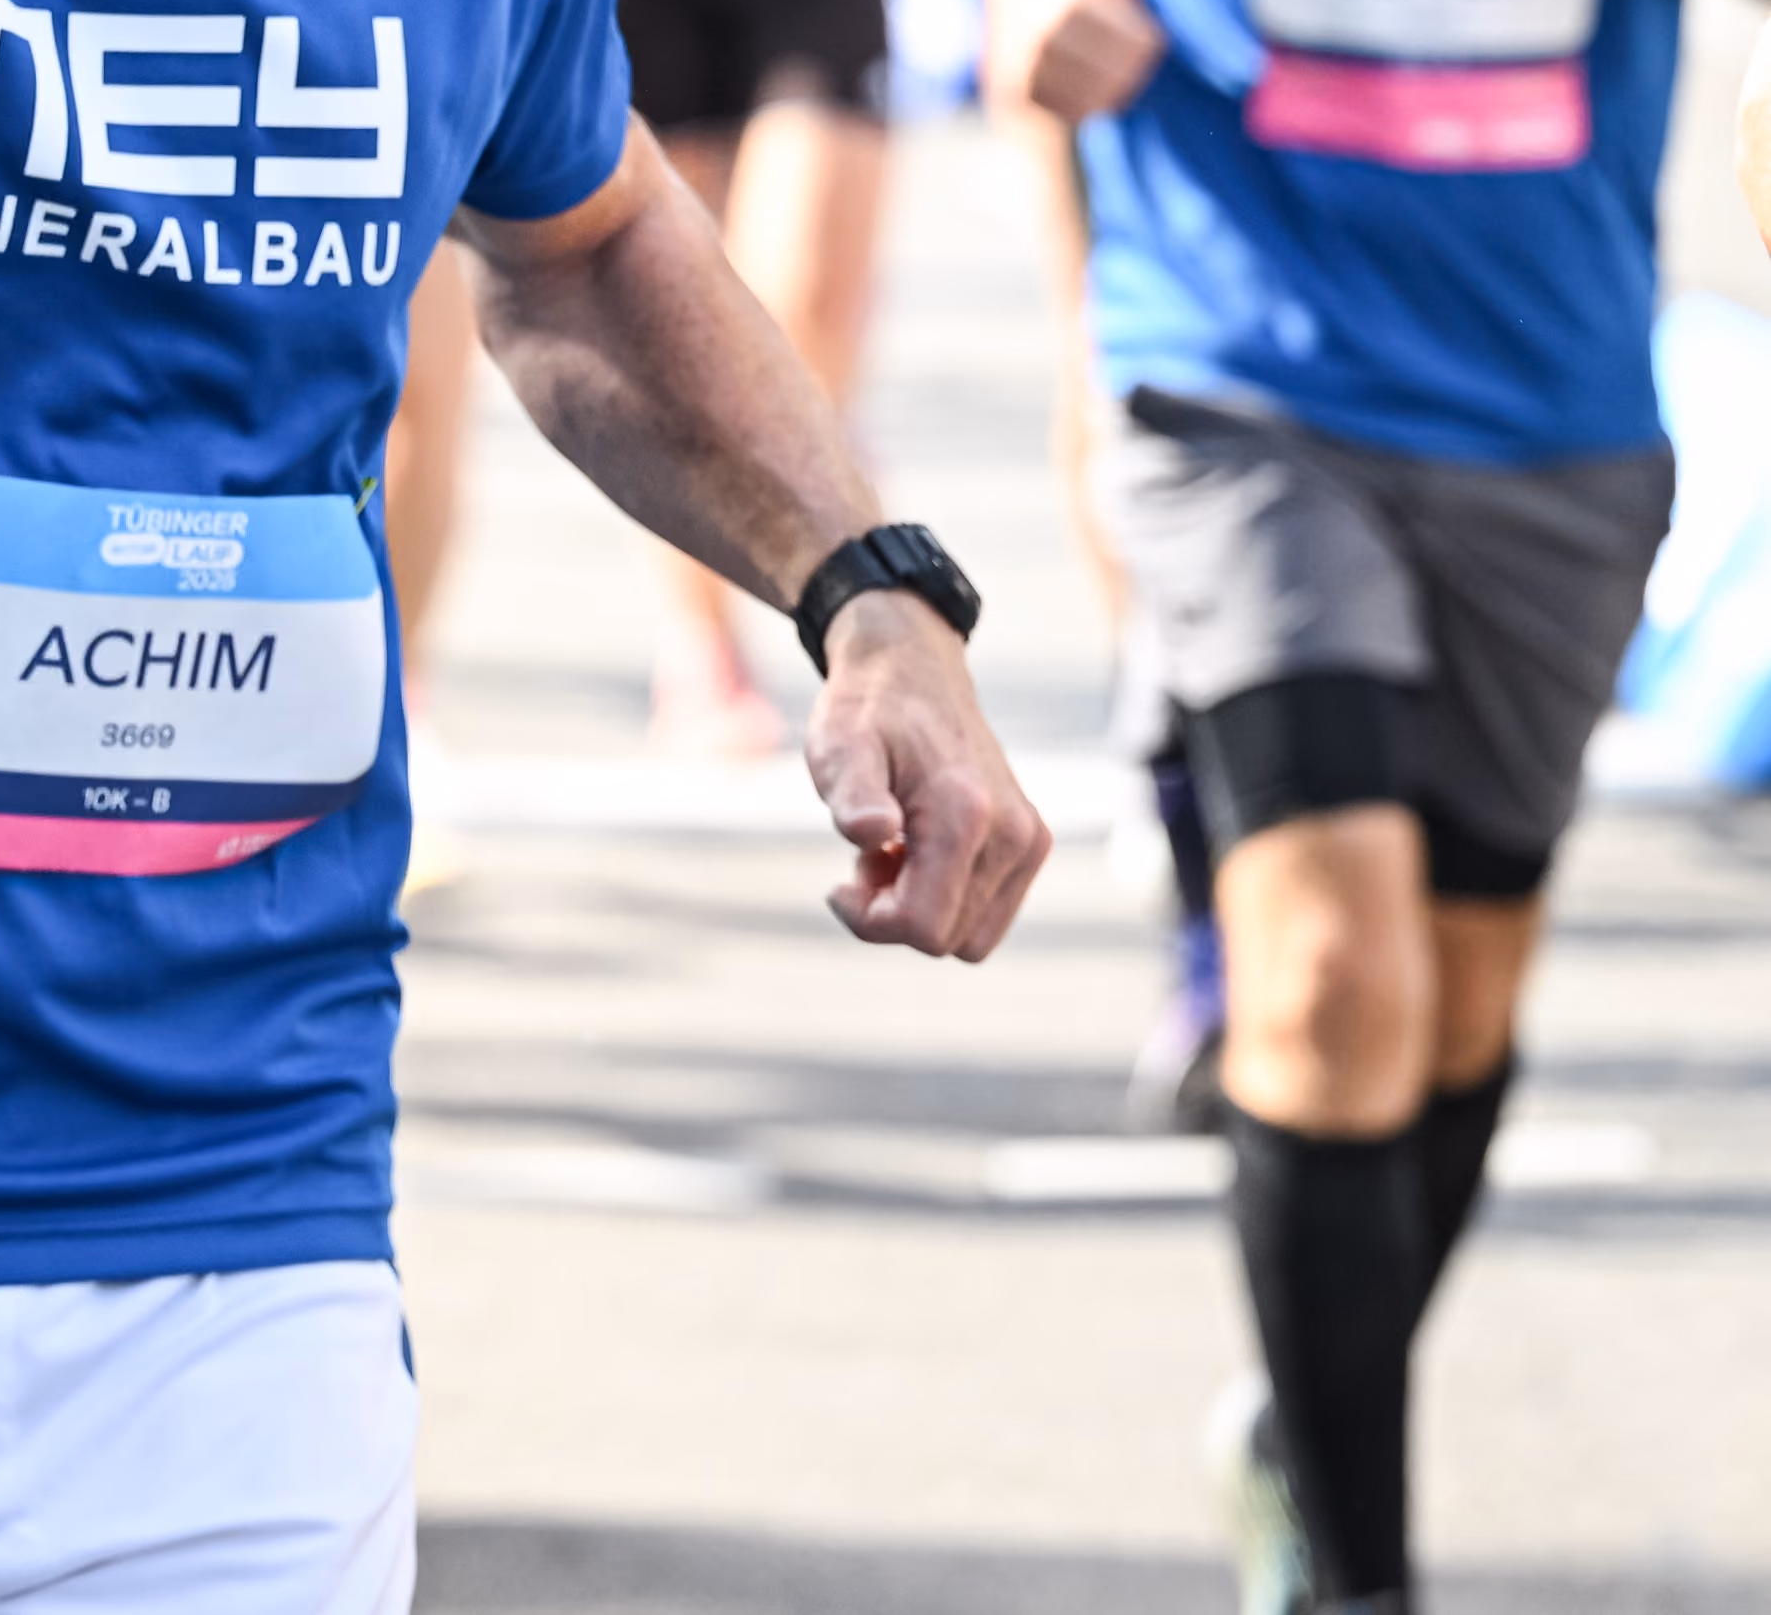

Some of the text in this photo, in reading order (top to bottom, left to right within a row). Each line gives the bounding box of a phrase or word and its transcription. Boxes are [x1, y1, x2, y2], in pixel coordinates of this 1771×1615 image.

[107, 502, 249, 536] TÜBINGER
[19, 625, 276, 693] ACHIM
[100, 722, 176, 749] 3669
[83, 786, 130, 812] 10K
